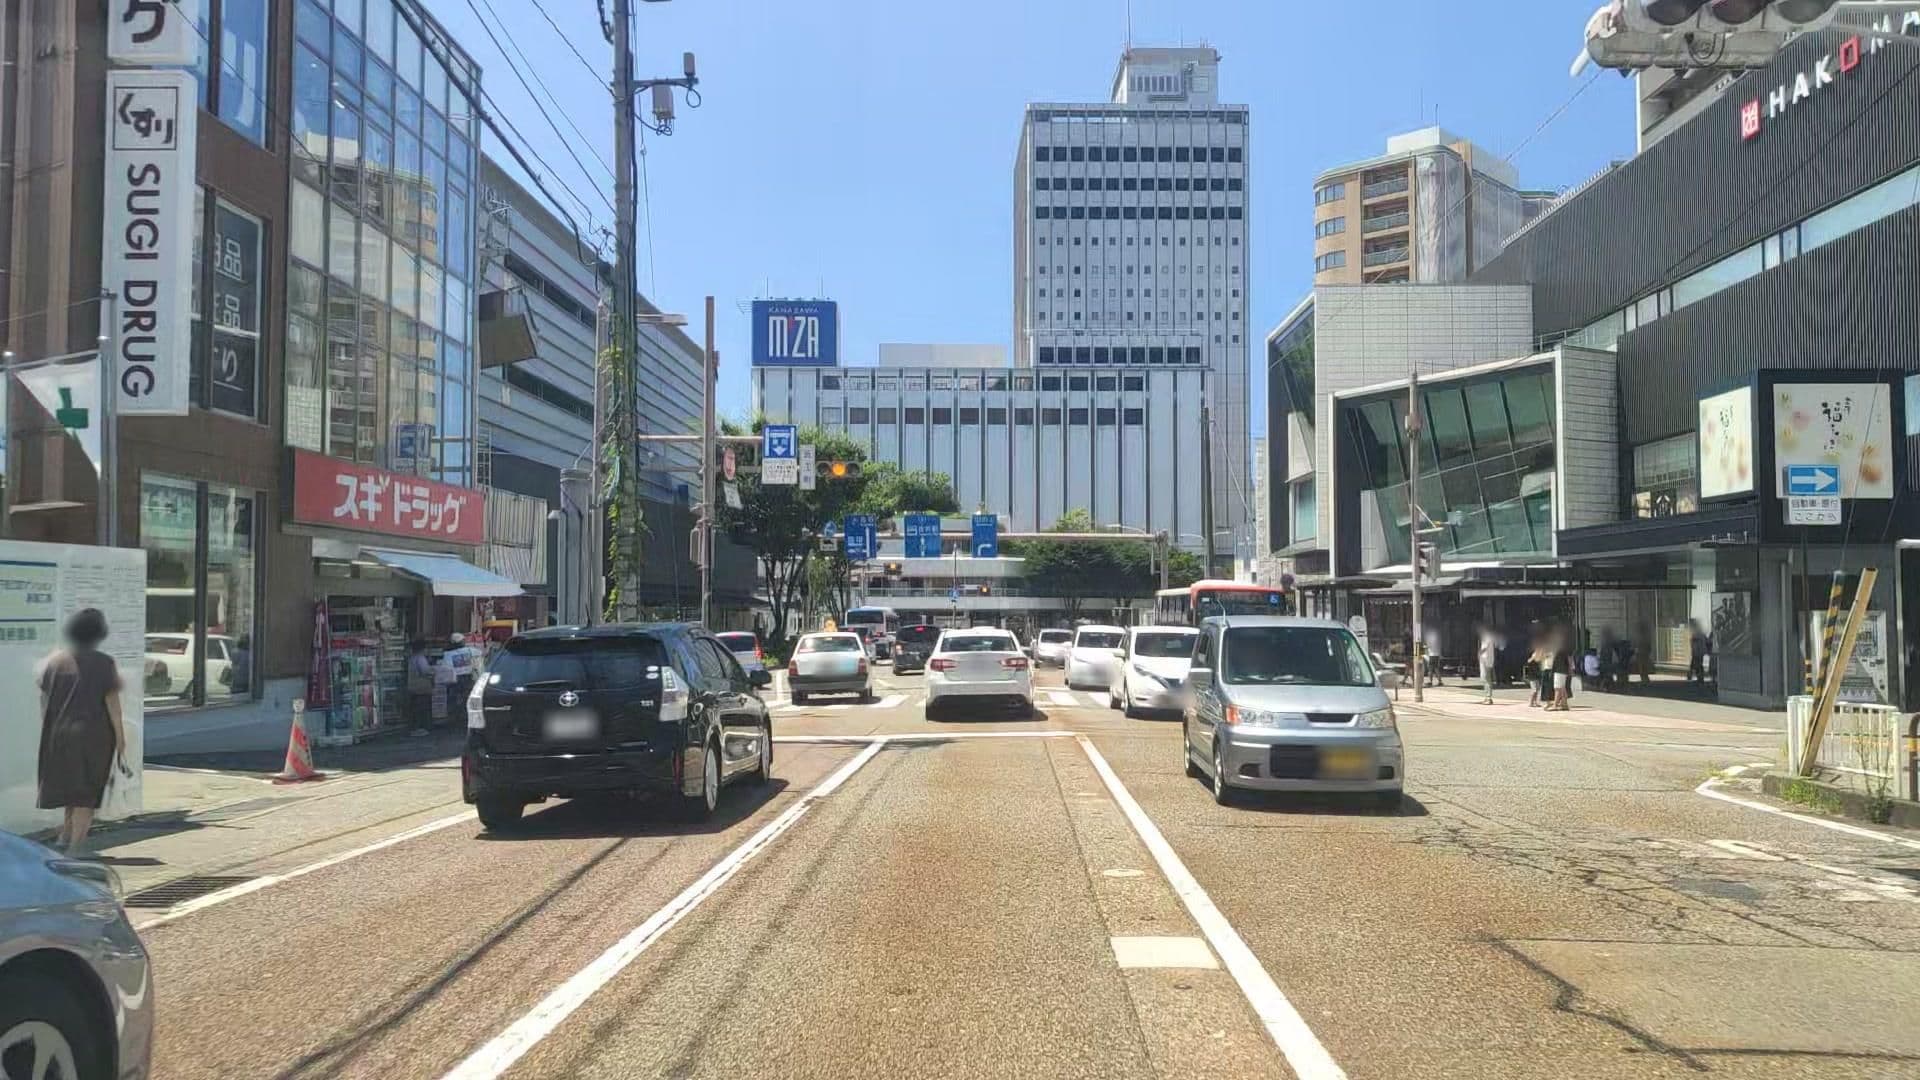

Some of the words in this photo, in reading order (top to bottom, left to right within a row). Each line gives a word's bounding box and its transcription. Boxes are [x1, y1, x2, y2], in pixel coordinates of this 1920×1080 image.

[125, 163, 160, 260] SUGI
[121, 280, 158, 398] DRUG
[333, 474, 467, 533] スギドラッグ
